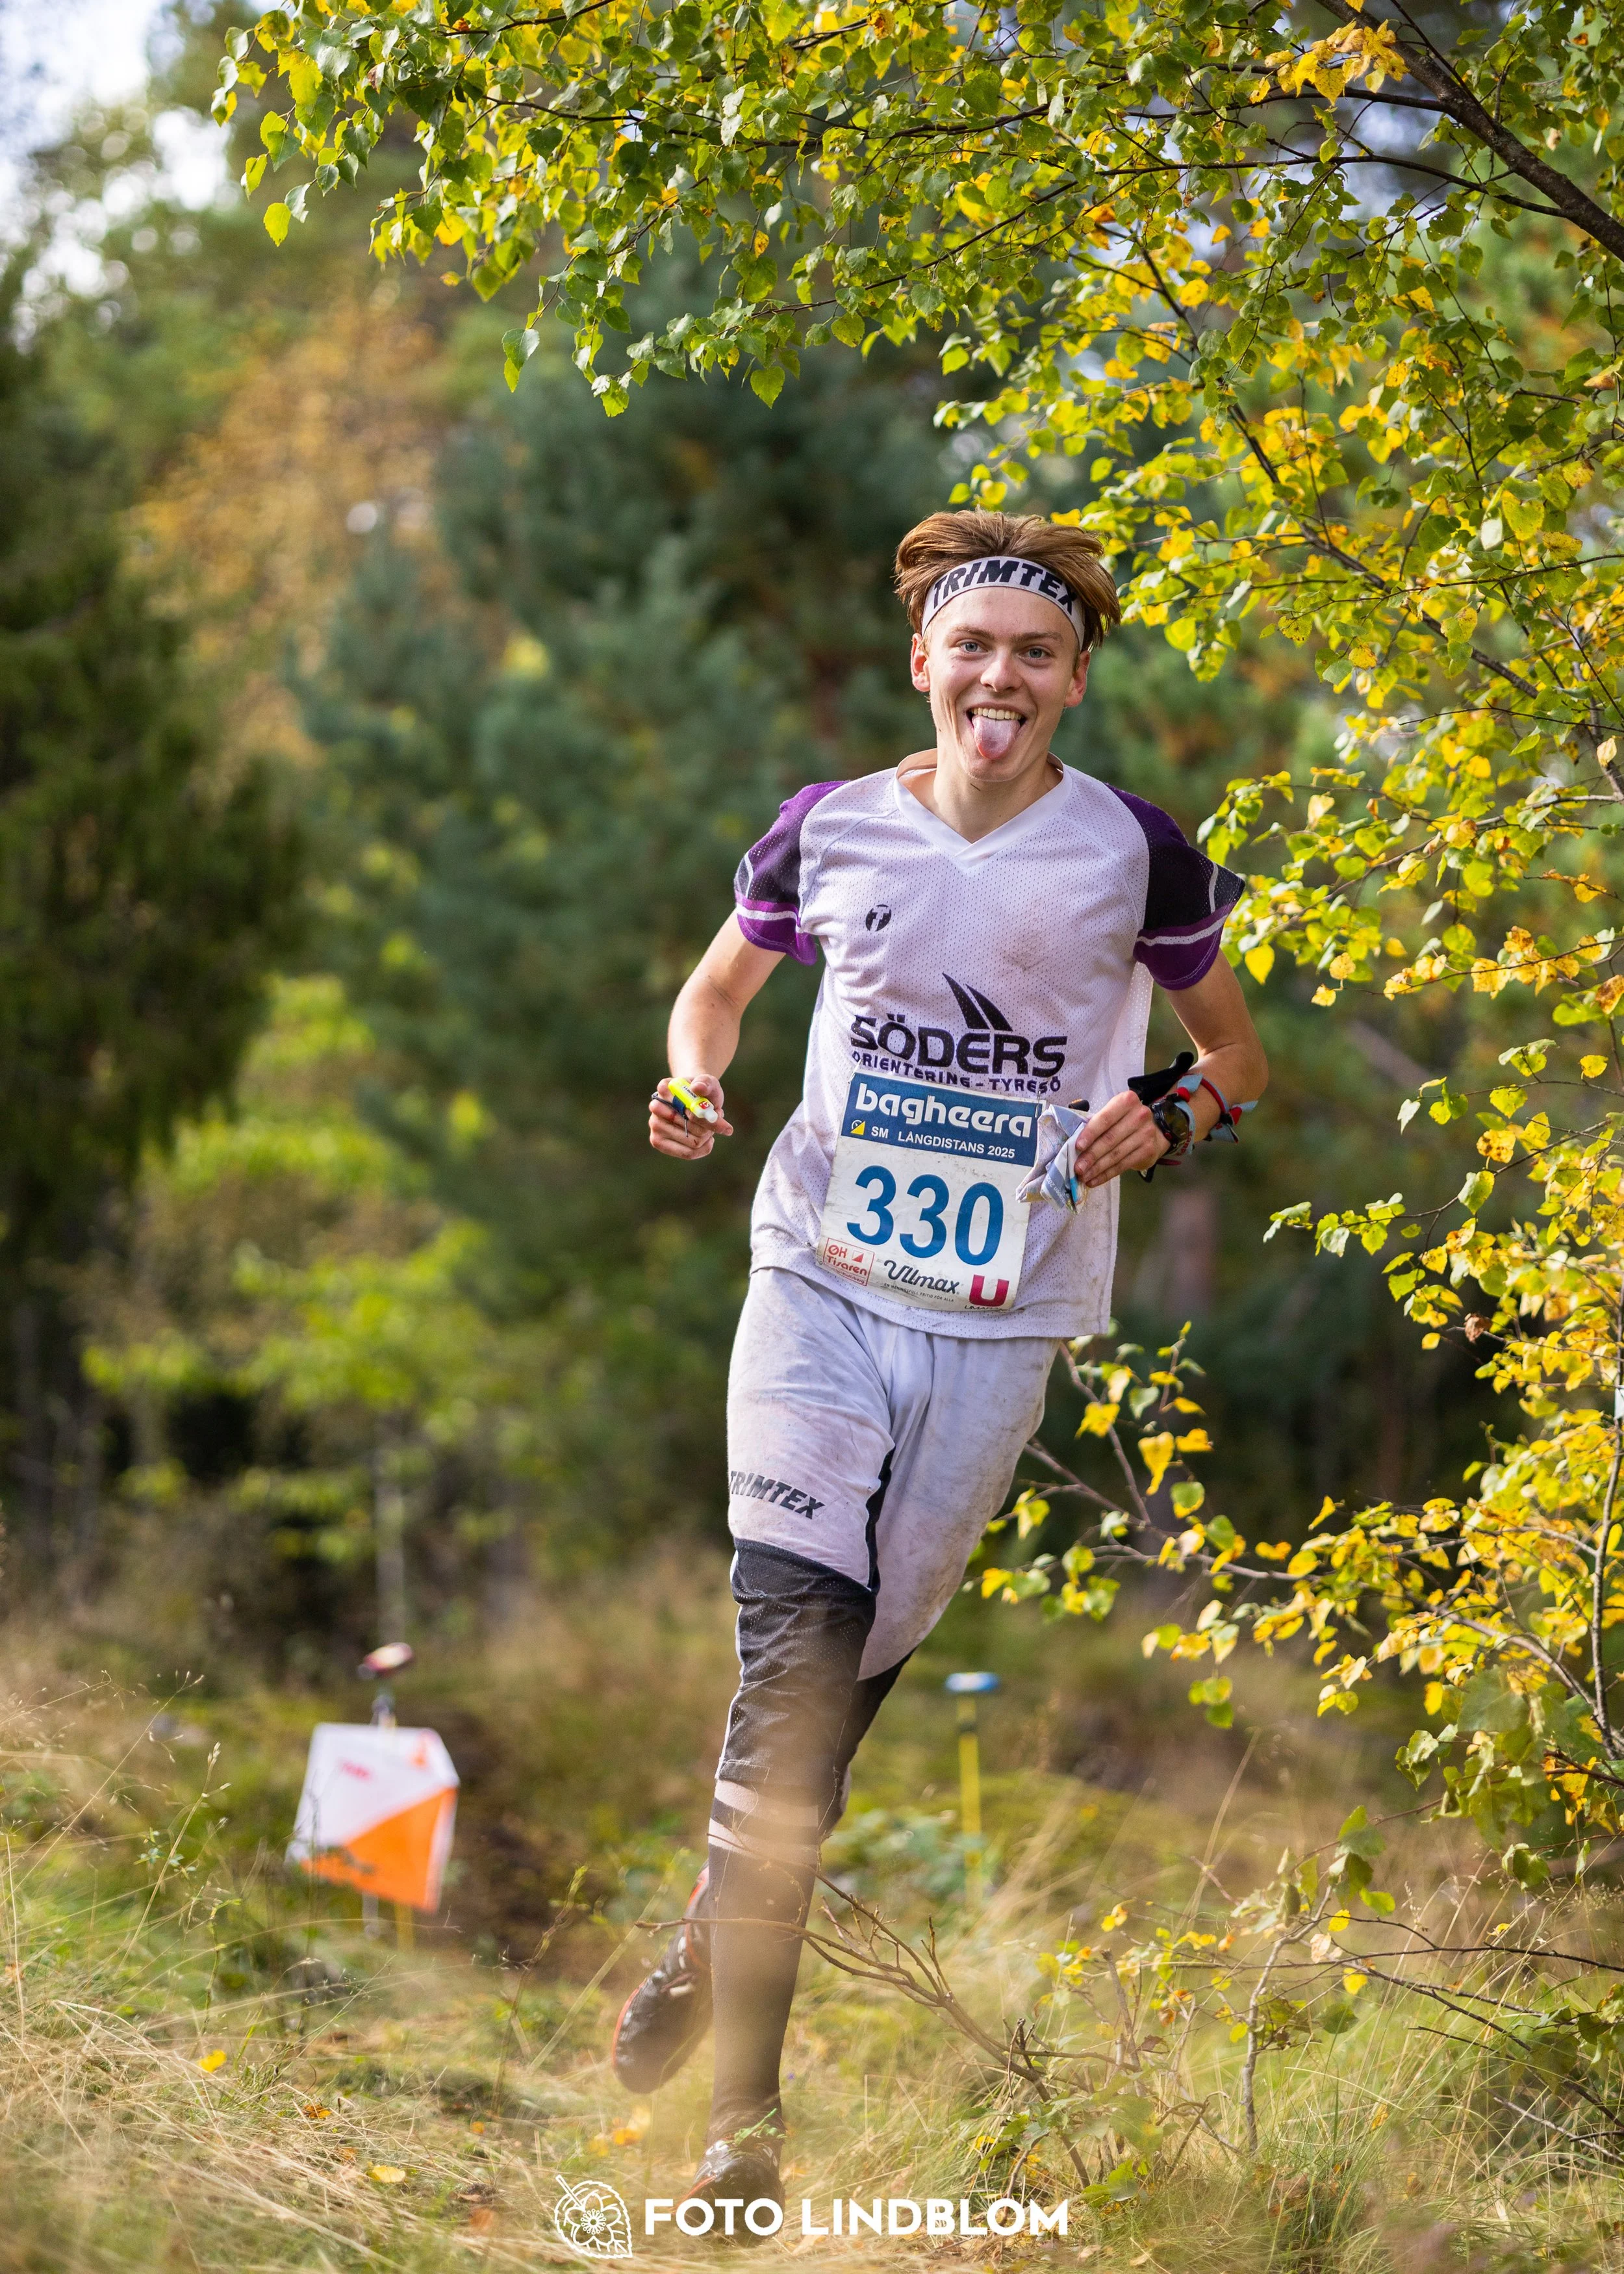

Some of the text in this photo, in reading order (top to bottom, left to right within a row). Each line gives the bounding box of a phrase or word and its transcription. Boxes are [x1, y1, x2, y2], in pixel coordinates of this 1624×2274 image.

[933, 559, 1078, 616] TRIMTEX
[851, 1013, 1068, 1078] SÖDERS
[852, 1051, 971, 1088] ORIENTERING
[989, 1076, 1061, 1094] TYRESÖ
[855, 1083, 1032, 1138] bagheera
[871, 1126, 1015, 1158] SM LÅNGDISTANS 2025
[846, 1165, 1004, 1266] 330
[826, 1255, 867, 1276] Tisaren
[884, 1259, 960, 1294] Ullmax
[730, 1470, 826, 1520] TRIMTEX
